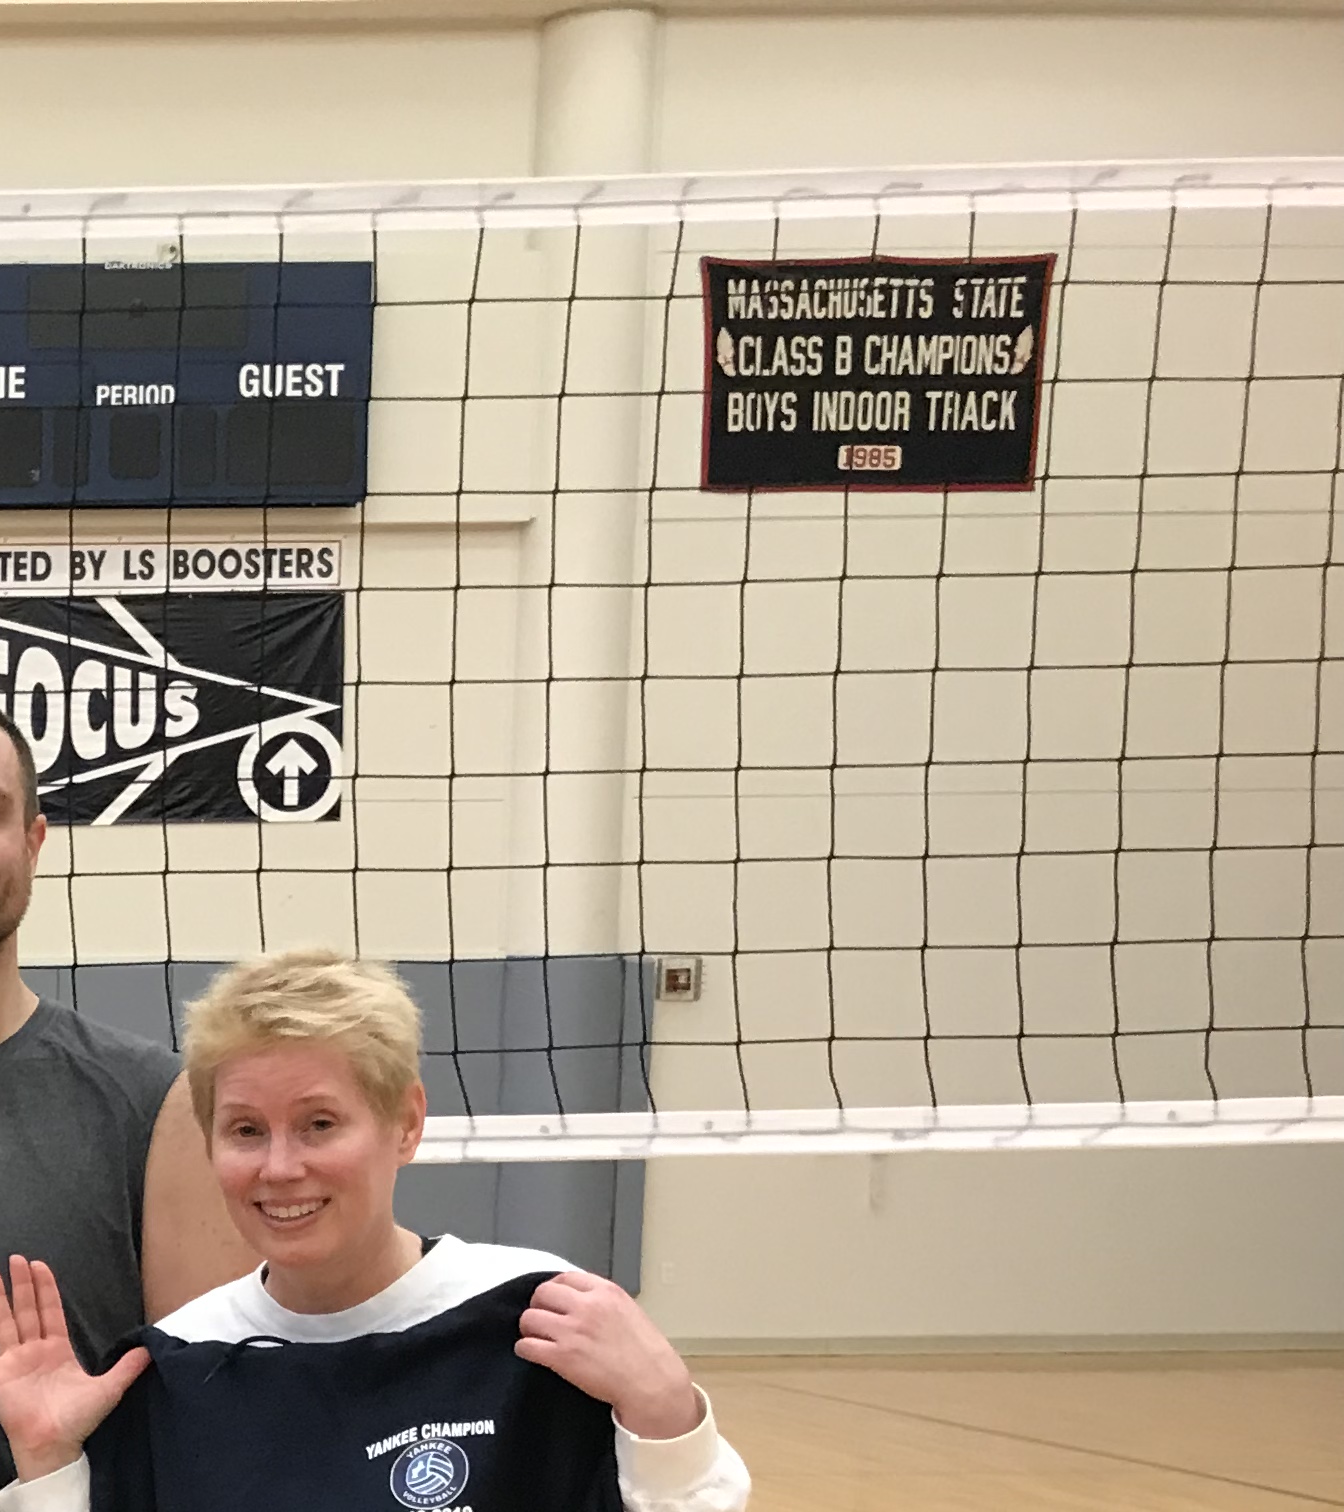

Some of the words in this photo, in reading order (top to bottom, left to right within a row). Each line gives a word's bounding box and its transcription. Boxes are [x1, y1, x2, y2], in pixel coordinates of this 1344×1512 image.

[727, 277, 934, 319] MASSACHUSETTS
[952, 275, 1027, 318] STATE
[738, 335, 823, 376] CLASS
[835, 335, 852, 376] B
[864, 334, 1013, 376] CHAMPIONS
[96, 384, 175, 407] PERIOD
[238, 364, 345, 398] GUEST
[727, 391, 798, 432] BOYS
[812, 390, 910, 432] INDOOR
[925, 390, 1018, 432] TRACK
[842, 447, 896, 468] 1985
[72, 549, 107, 581] BY
[123, 549, 155, 580] LS
[172, 547, 335, 580] BOOSTERS
[366, 1427, 418, 1460] YANKEE
[421, 1420, 495, 1439] CHAMPION
[406, 1442, 452, 1459] YANKEE
[403, 1486, 457, 1505] VOLLEYBALL
